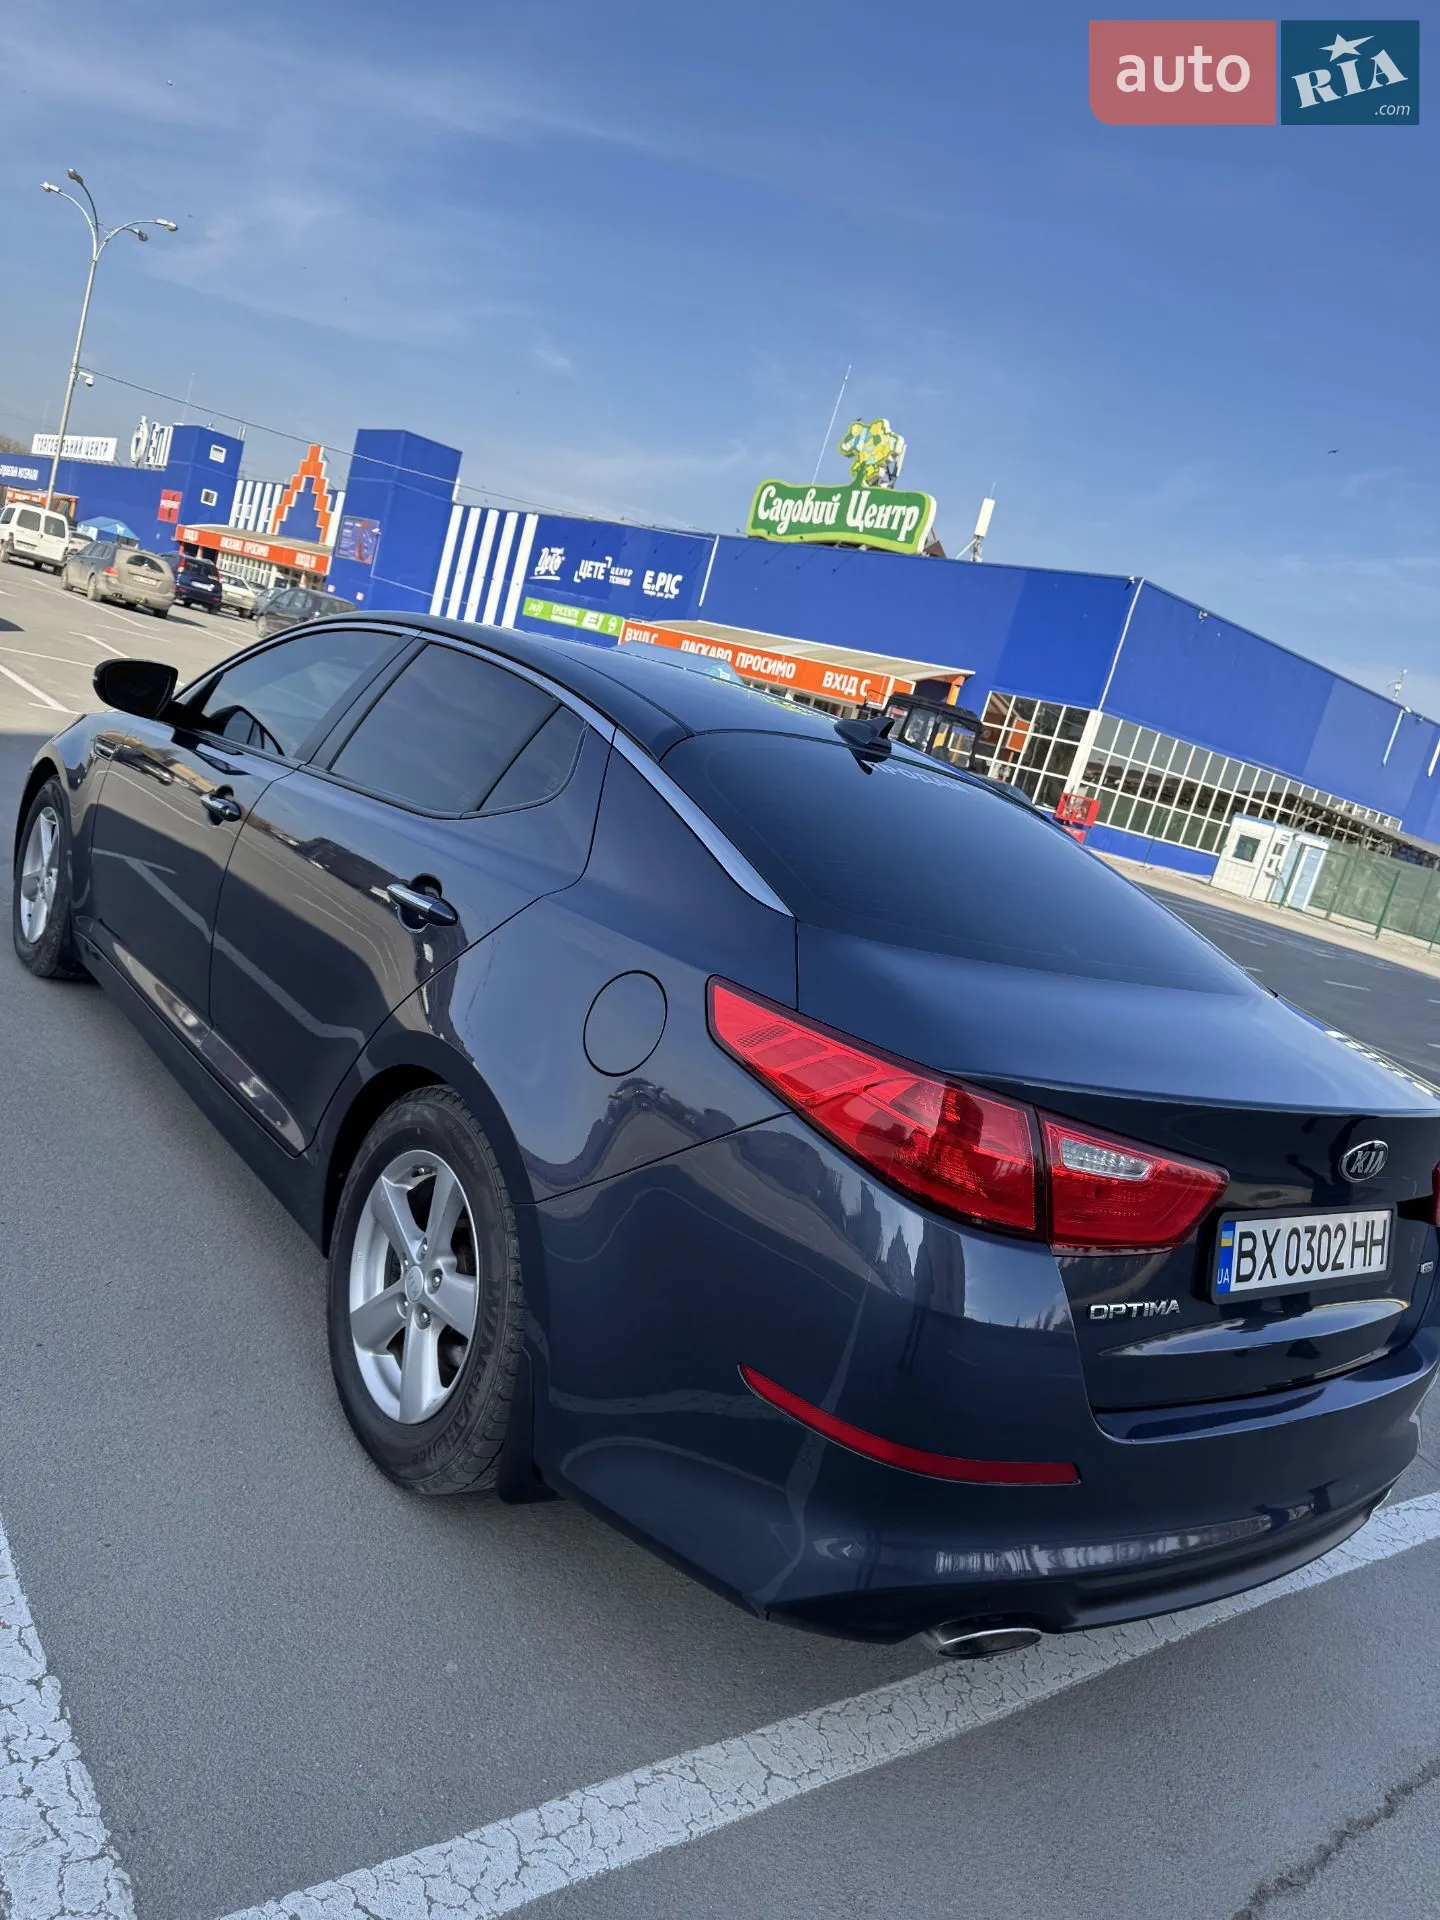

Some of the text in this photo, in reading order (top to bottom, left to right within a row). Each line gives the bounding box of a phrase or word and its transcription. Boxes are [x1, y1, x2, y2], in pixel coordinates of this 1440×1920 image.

[757, 485, 920, 541] Садовий Центр
[735, 652, 797, 679] ПРОСИМО
[821, 670, 859, 697] ВХІД
[1349, 1150, 1384, 1173] KIA
[1216, 1269, 1230, 1285] UA
[1089, 1299, 1181, 1320] OPTIMA
